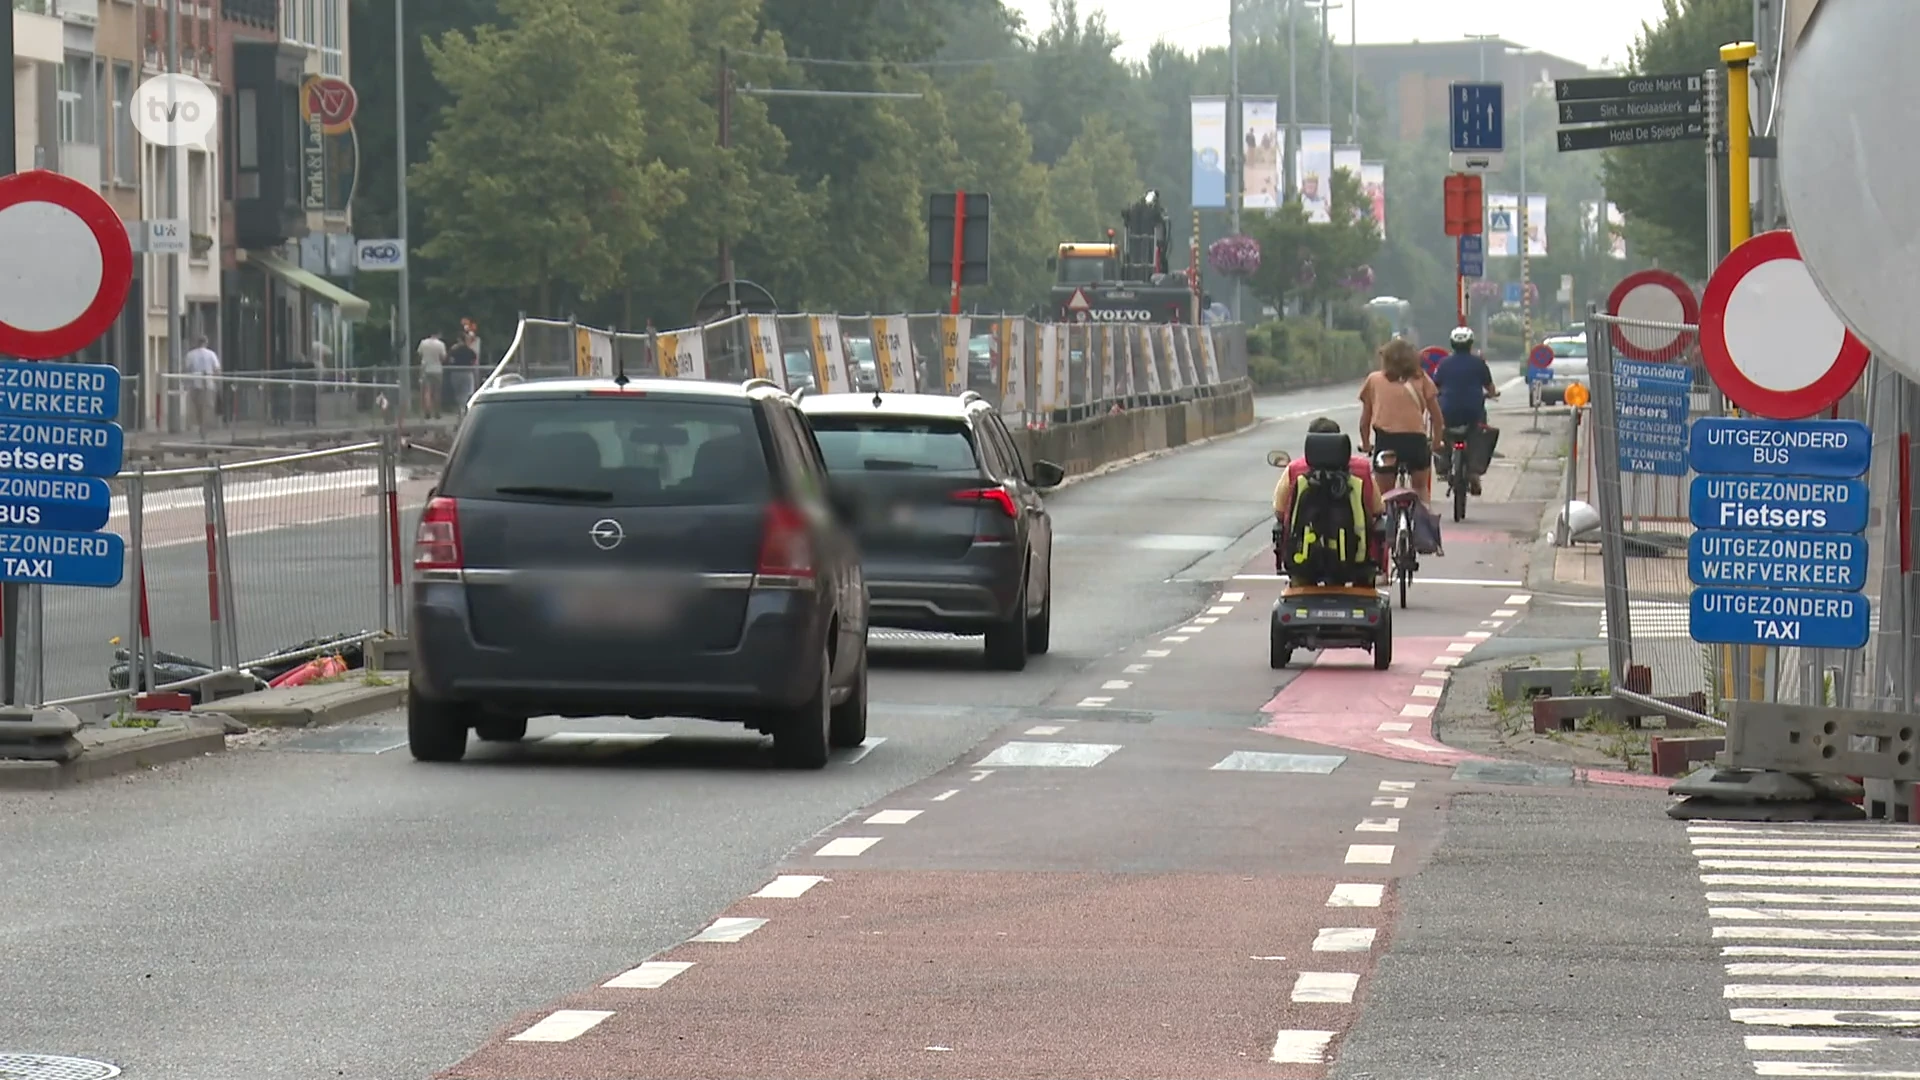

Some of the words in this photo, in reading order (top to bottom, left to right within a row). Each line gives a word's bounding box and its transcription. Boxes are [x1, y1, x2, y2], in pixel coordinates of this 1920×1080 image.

[1628, 80, 1654, 93] Grote
[1657, 79, 1682, 91] Markt
[1600, 104, 1618, 117] Sint
[1627, 102, 1682, 115] Nicolaaskerk
[1610, 128, 1634, 142] Hotel
[1636, 127, 1649, 139] De
[1651, 124, 1684, 140] Spiegel
[1088, 309, 1151, 321] VOLVO
[1707, 428, 1849, 449] UITGEZONDERD
[1631, 459, 1655, 471] TAXI
[1753, 448, 1790, 464] BUS
[1707, 480, 1849, 503] UITGEZONDERD
[0, 505, 41, 524] BUS
[1720, 502, 1827, 528] Fietsers
[1702, 537, 1853, 560] UITGEZONDERD
[3, 557, 53, 578] TAXI
[1701, 560, 1851, 584] WERFVERKEER
[1702, 594, 1854, 618] UITGEZONDERD
[1753, 619, 1801, 640] TAXI
